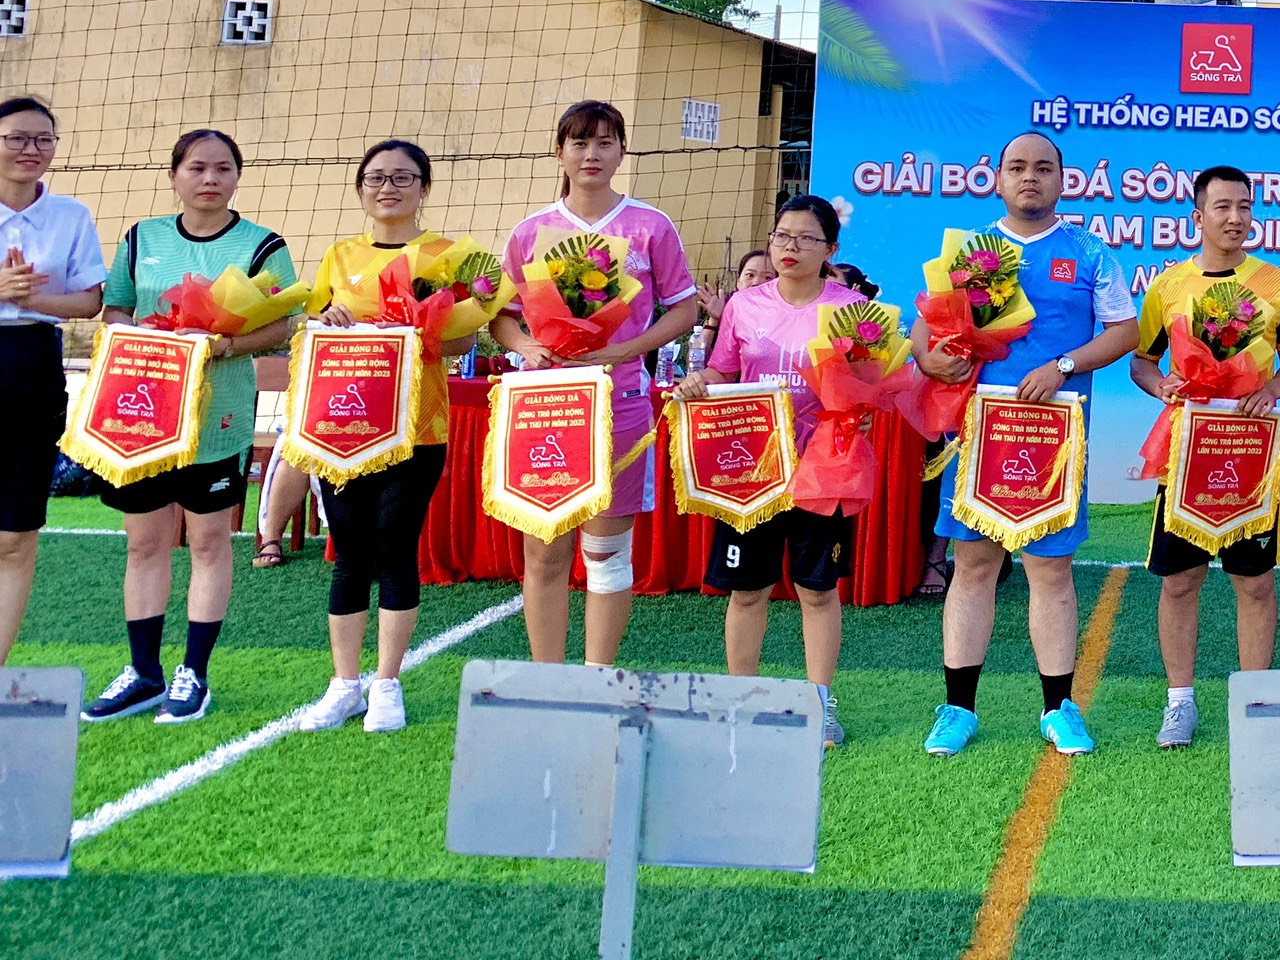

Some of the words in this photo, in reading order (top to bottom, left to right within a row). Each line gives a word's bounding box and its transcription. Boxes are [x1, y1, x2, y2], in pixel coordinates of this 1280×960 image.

[1190, 72, 1220, 81] SÔNG
[1032, 97, 1068, 130] HỆ
[1074, 95, 1169, 127] THỐNG
[1175, 106, 1248, 128] HEAD
[854, 153, 933, 193] GIẢI
[941, 156, 1002, 194] BÓ
[1061, 159, 1113, 198] ĐÁ
[1122, 161, 1202, 200] SÔN
[1056, 214, 1144, 246] EAM
[726, 544, 740, 568] 9
